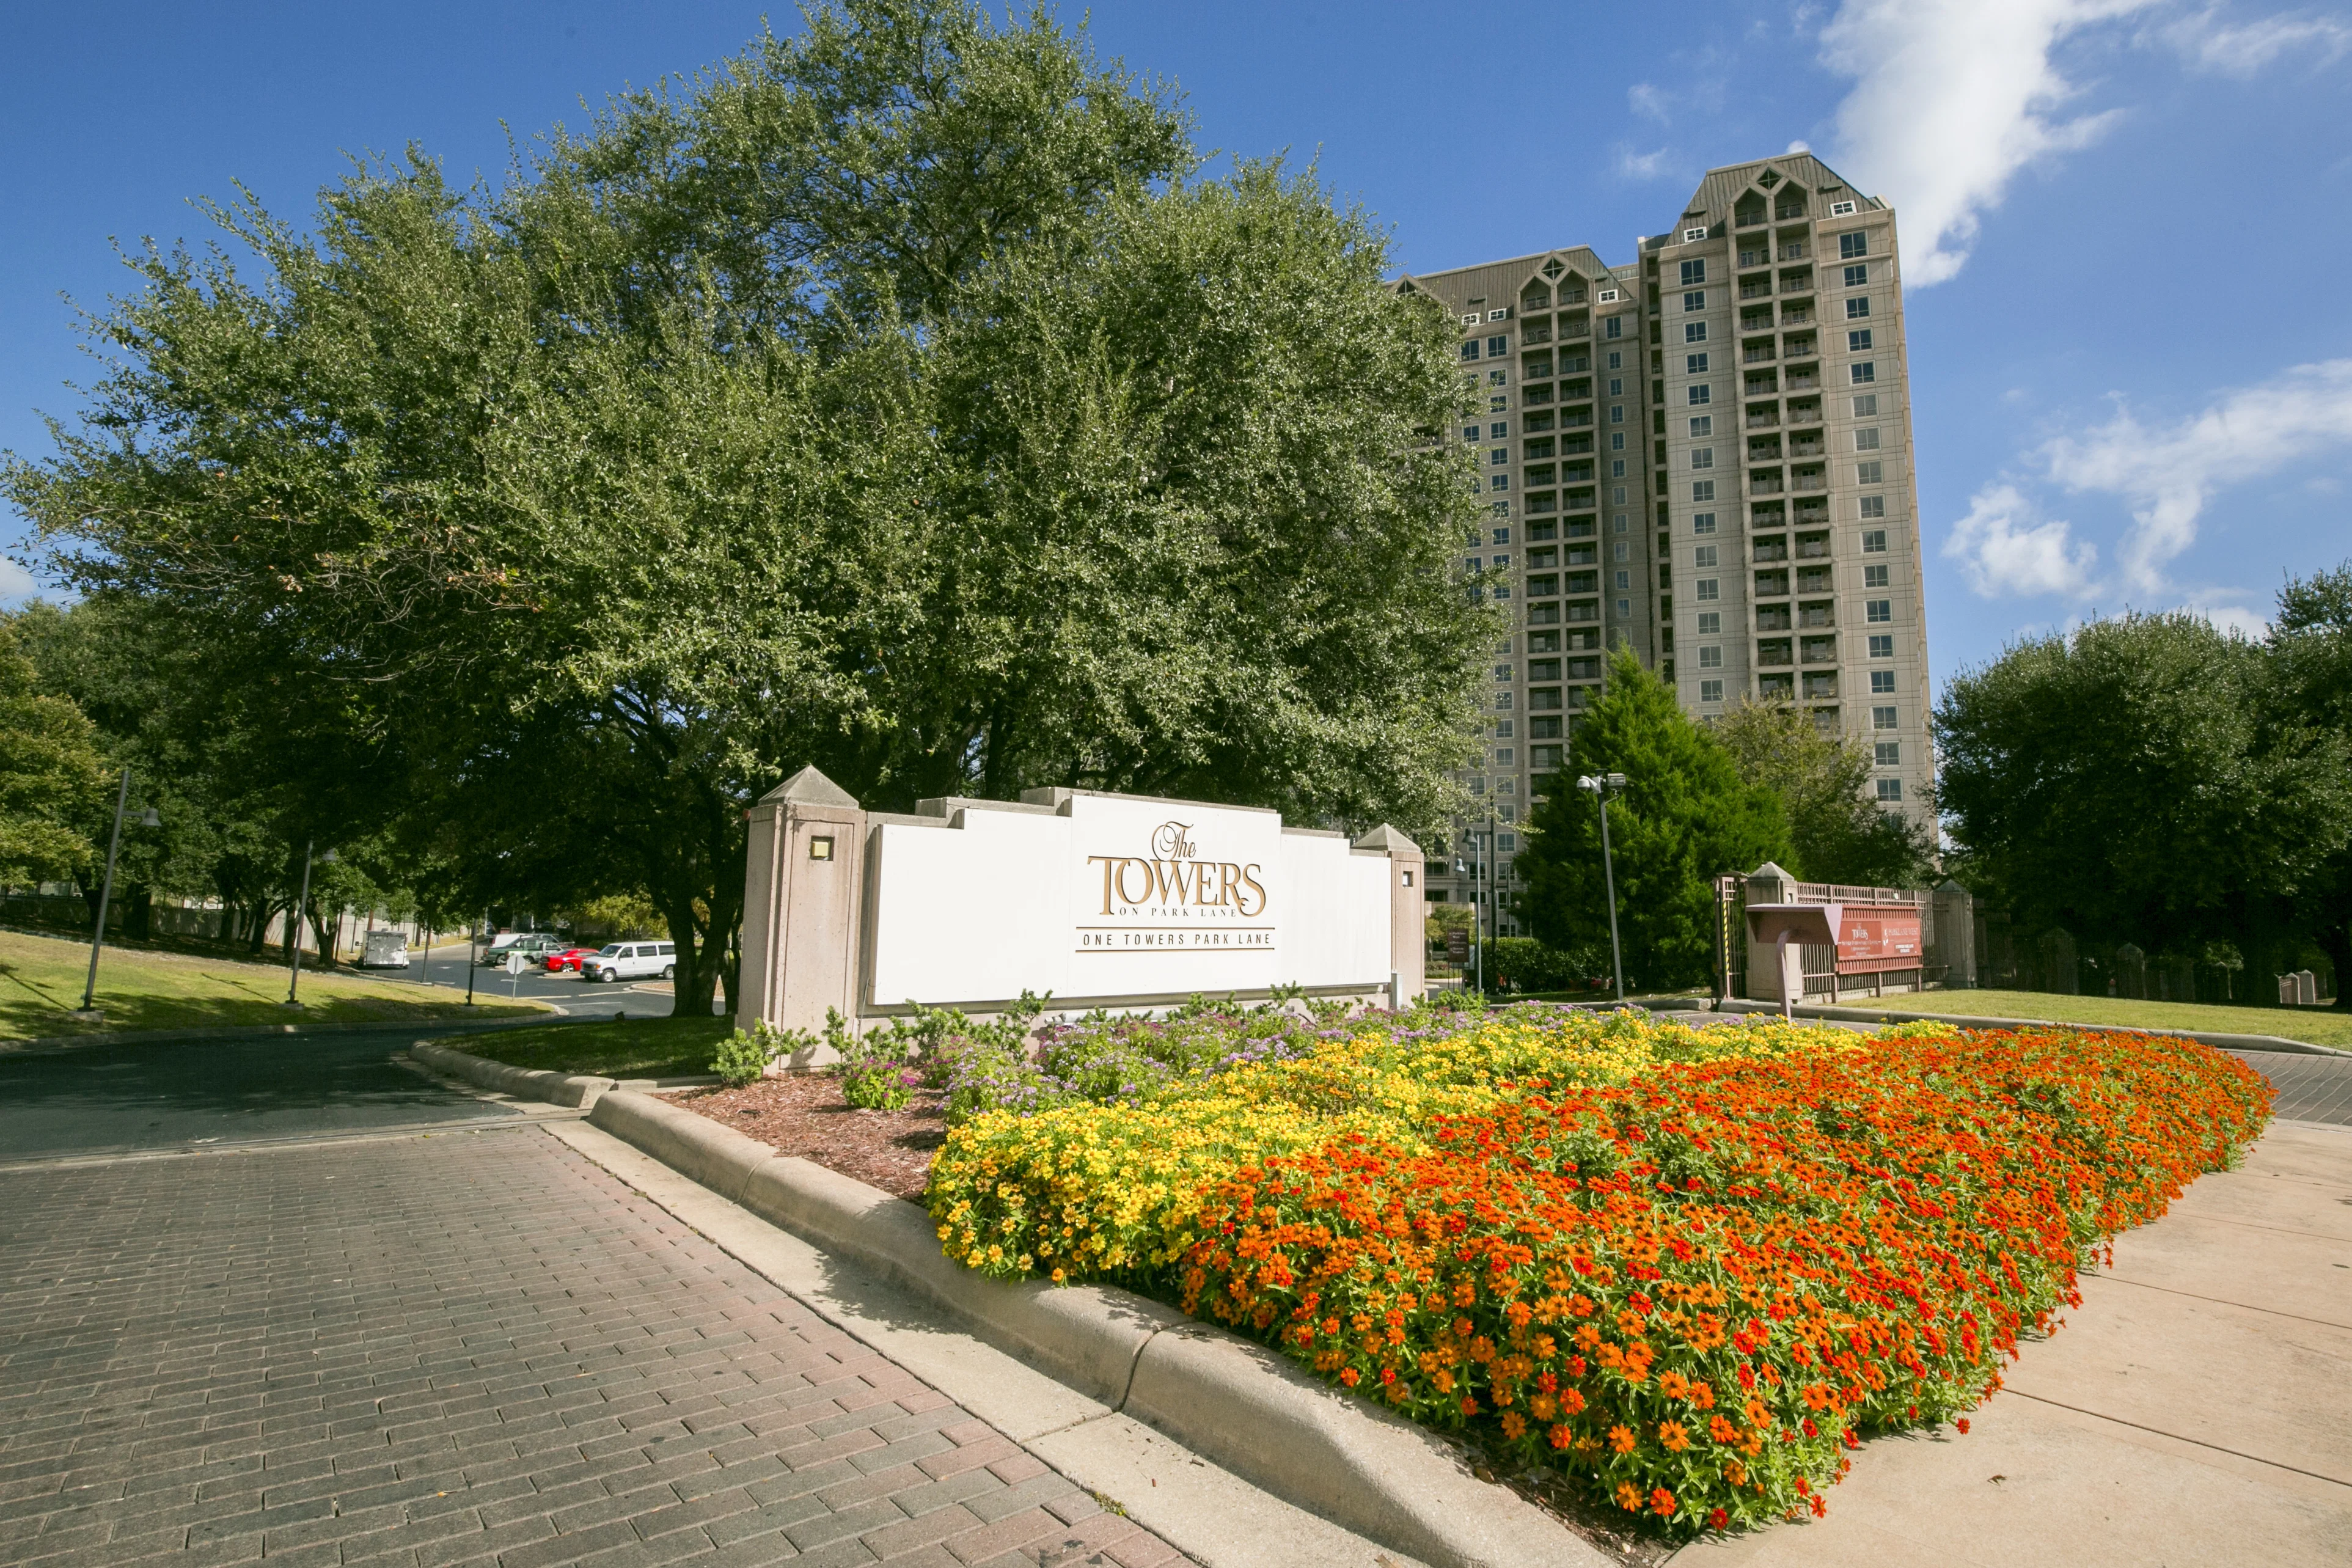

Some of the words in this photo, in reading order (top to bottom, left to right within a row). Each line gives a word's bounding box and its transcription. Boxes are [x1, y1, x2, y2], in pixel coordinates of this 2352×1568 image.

[1152, 821, 1196, 862] The
[1087, 856, 1266, 917] TOWERS
[1119, 907, 1138, 916] ON
[1151, 907, 1189, 917] PARK
[1201, 909, 1236, 917] LANE
[1083, 934, 1112, 945] ONE
[1124, 934, 1184, 945] TOWERS
[1195, 934, 1228, 945] PARK
[1239, 934, 1269, 944] LANE
